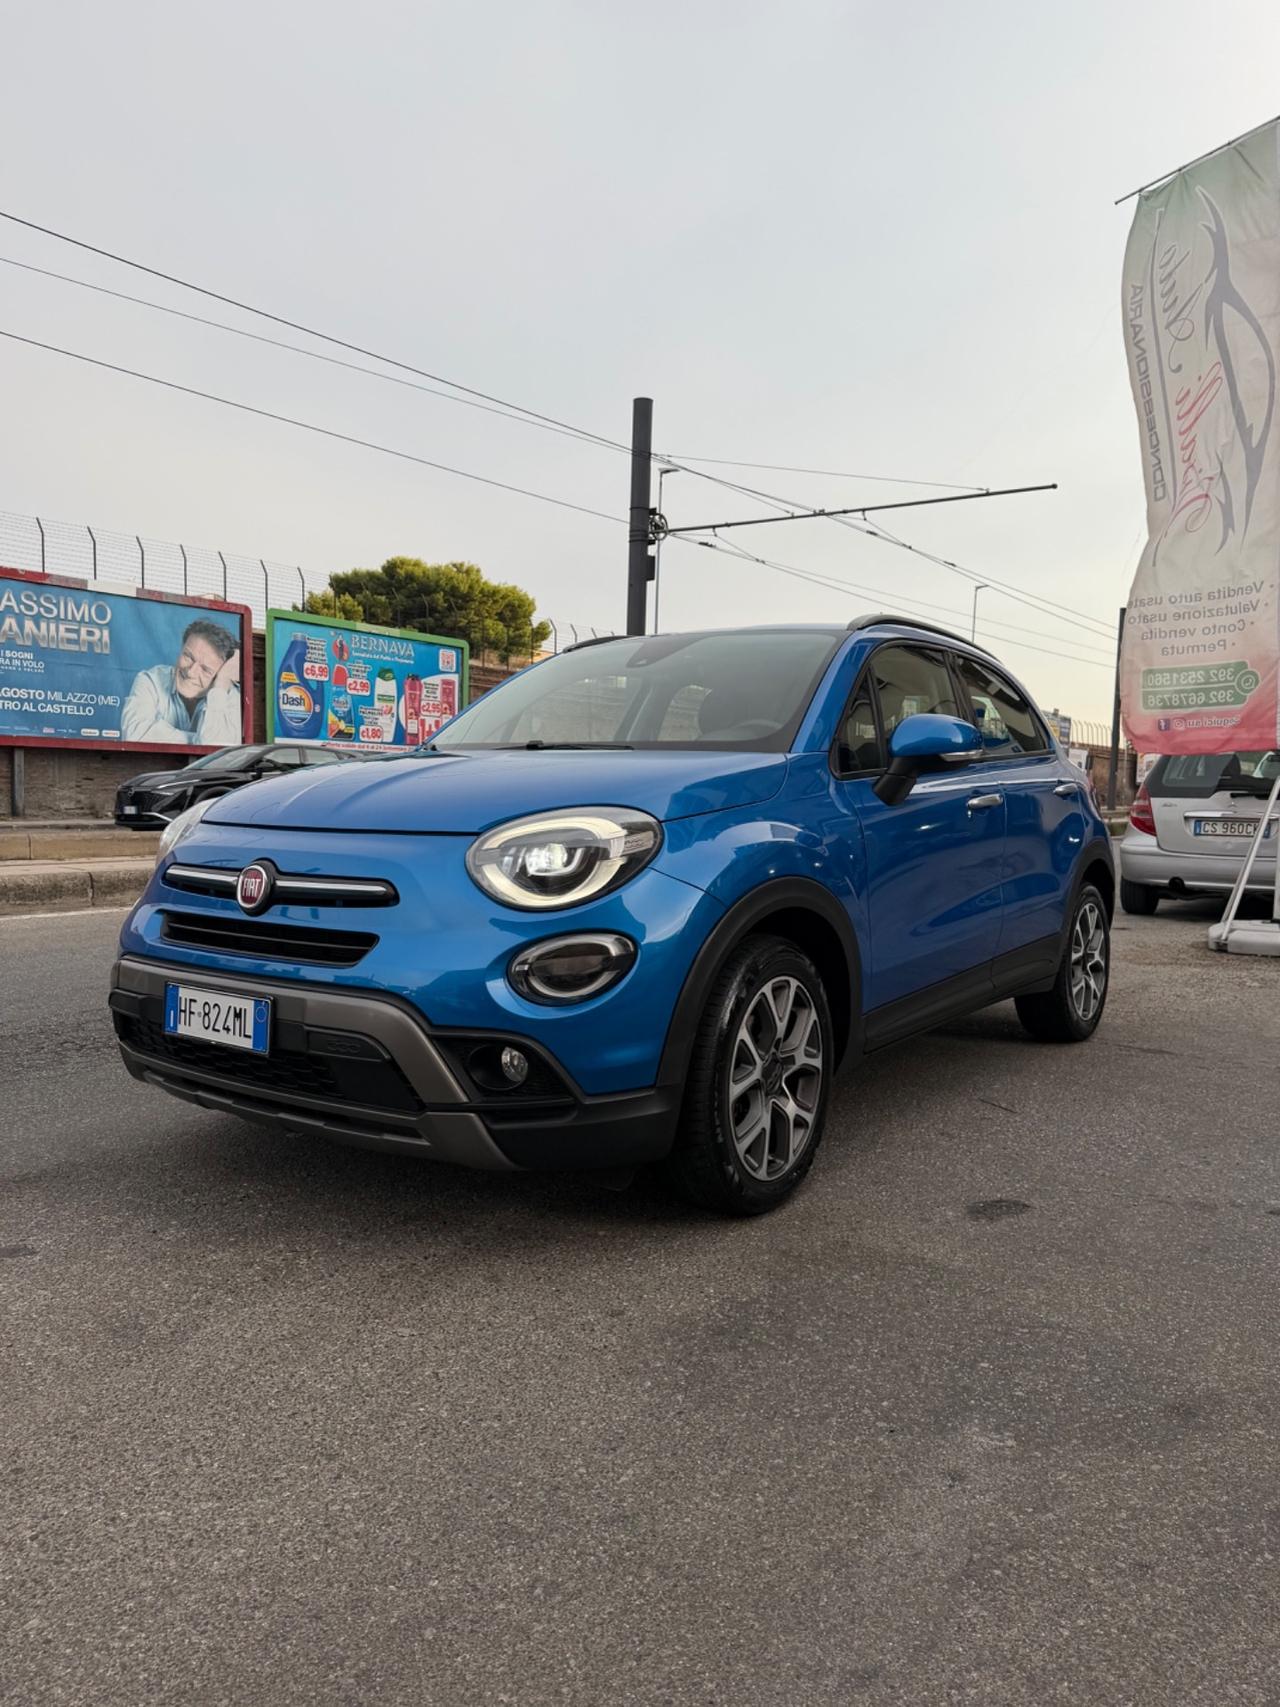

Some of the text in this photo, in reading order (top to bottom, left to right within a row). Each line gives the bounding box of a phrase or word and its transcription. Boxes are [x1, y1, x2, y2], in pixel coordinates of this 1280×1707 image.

[352, 634, 415, 657] BERNAVA
[5, 650, 34, 660] SOGNI
[12, 659, 21, 667] IN
[22, 660, 45, 669] VOLO
[0, 687, 120, 707] GOSTO MILAZZO (ME)
[282, 693, 306, 707] Dash
[22, 702, 37, 712] AL
[37, 703, 94, 716] CASTELLO
[1203, 822, 1218, 833] CS
[242, 878, 262, 897] FIAT
[178, 996, 198, 1027] HF
[202, 1001, 252, 1039] 824ML
